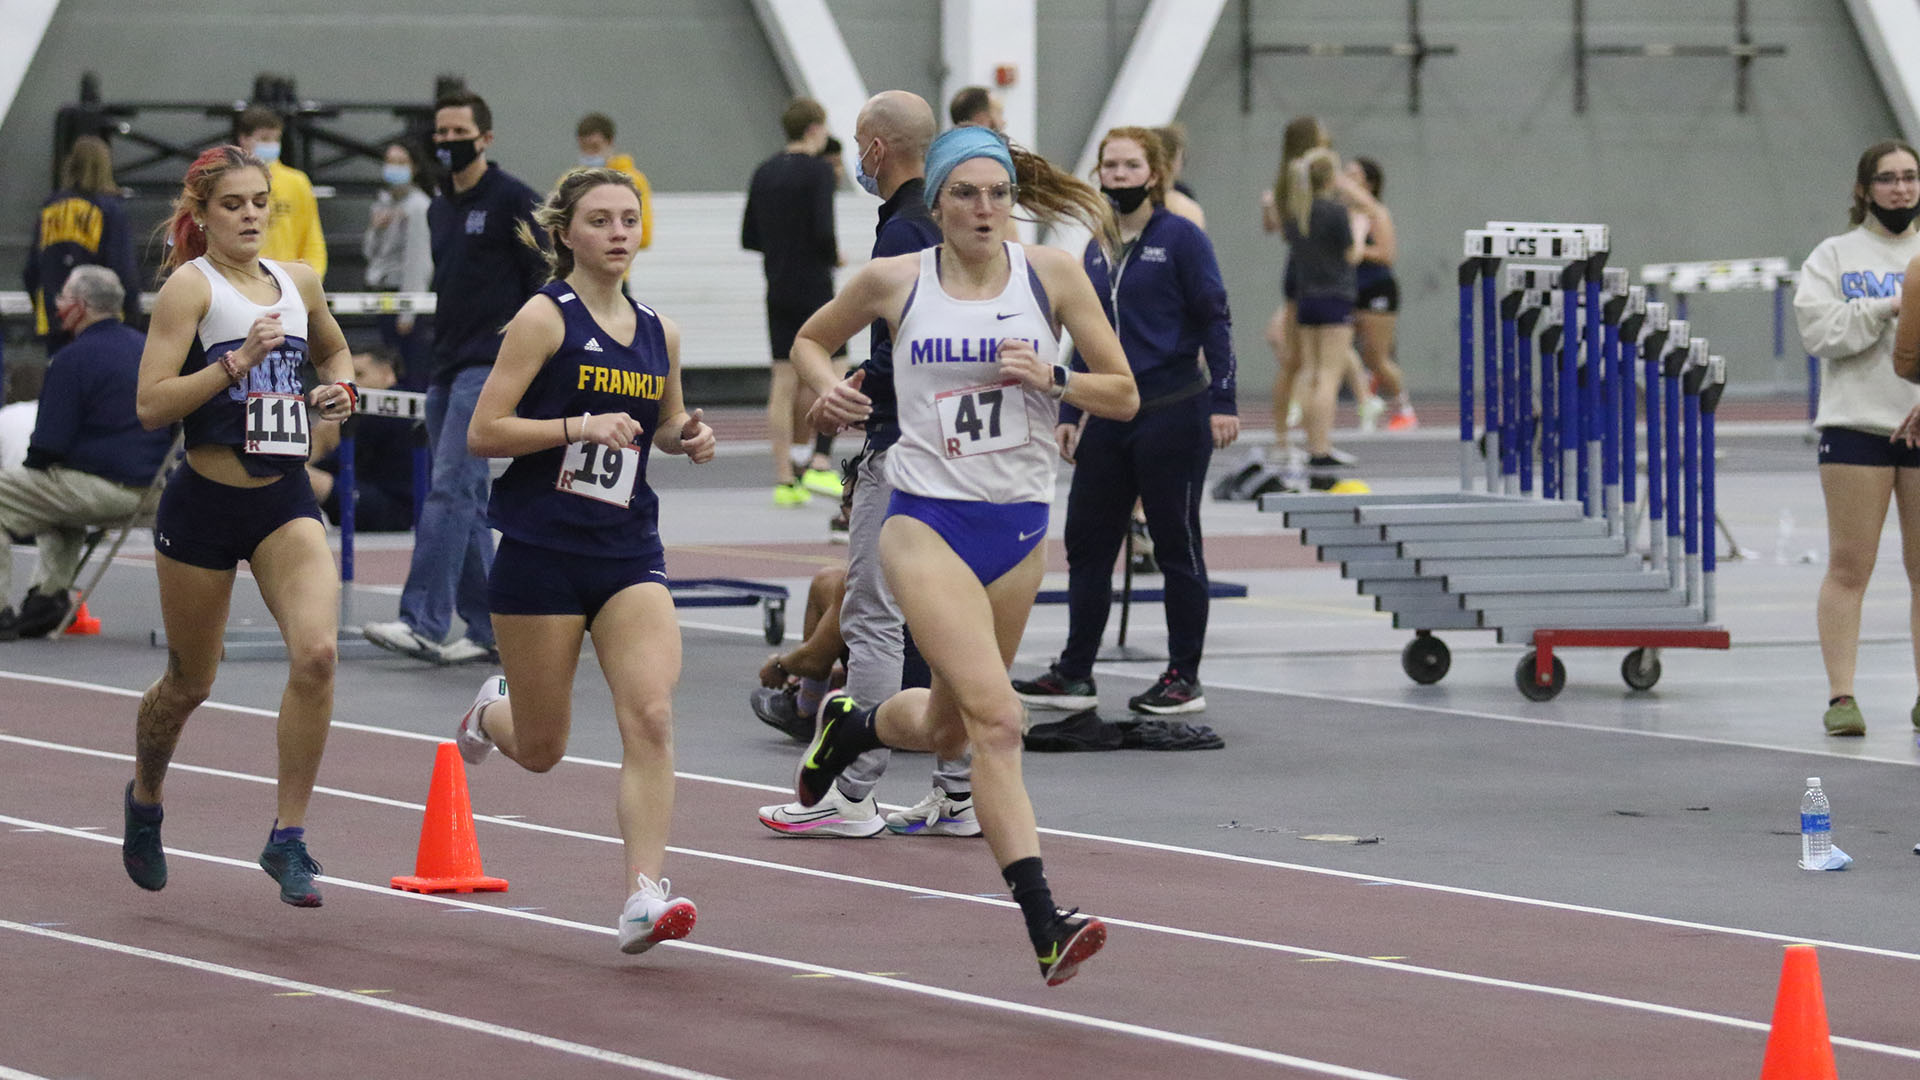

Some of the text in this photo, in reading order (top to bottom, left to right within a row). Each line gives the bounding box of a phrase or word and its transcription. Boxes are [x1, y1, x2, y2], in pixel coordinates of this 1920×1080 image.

[1507, 238, 1537, 255] UCS
[1841, 270, 1905, 301] SM
[378, 395, 399, 413] UCS
[955, 389, 1004, 442] 47
[247, 398, 307, 444] 111
[947, 438, 962, 456] R
[574, 443, 623, 490] 19
[561, 470, 575, 490] R
